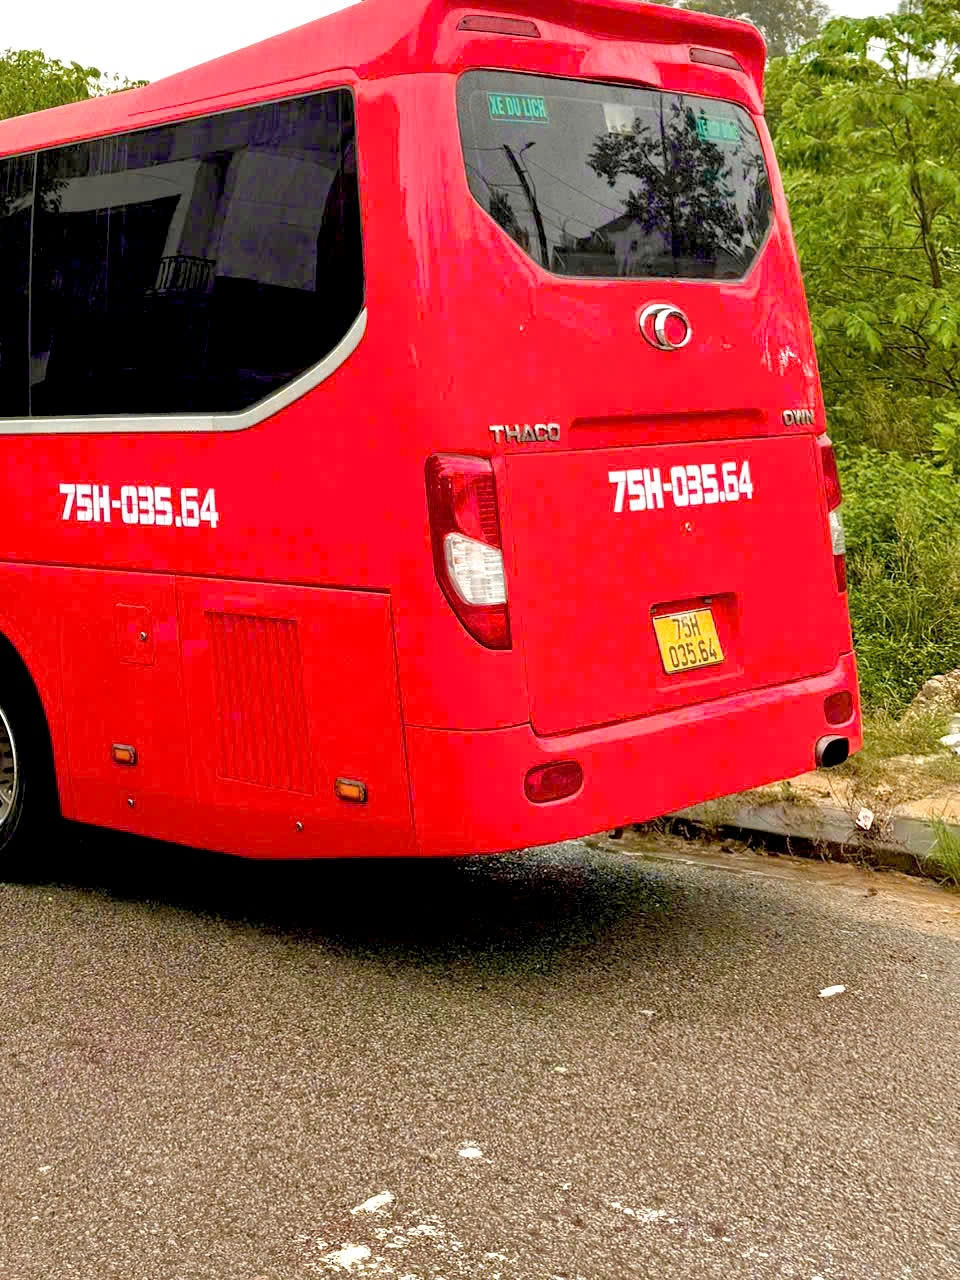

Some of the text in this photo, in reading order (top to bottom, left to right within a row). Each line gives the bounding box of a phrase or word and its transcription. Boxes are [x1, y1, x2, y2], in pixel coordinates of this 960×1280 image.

[489, 95, 504, 114] XE
[505, 96, 521, 116] DU
[488, 422, 561, 445] THACO
[608, 461, 754, 513] 75H-035.64
[59, 483, 219, 528] 75H-035.64
[672, 614, 701, 639] 75H
[668, 638, 718, 668] 035.64
